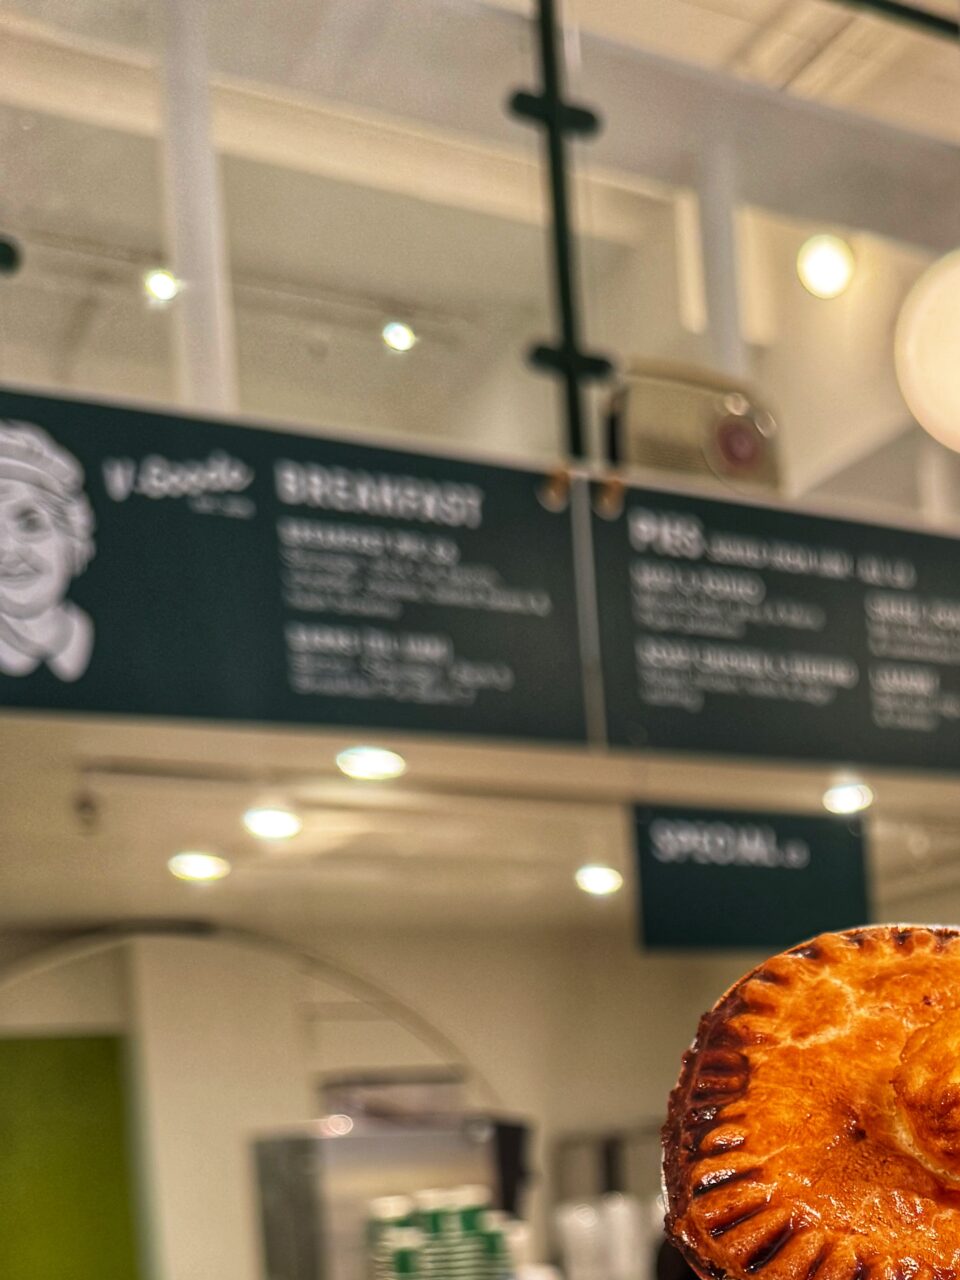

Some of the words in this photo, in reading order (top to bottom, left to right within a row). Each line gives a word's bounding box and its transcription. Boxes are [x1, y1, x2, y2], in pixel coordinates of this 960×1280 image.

[274, 460, 484, 529] BREAKFAST
[629, 508, 702, 559] PIES
[652, 819, 777, 868] SPECIAL
